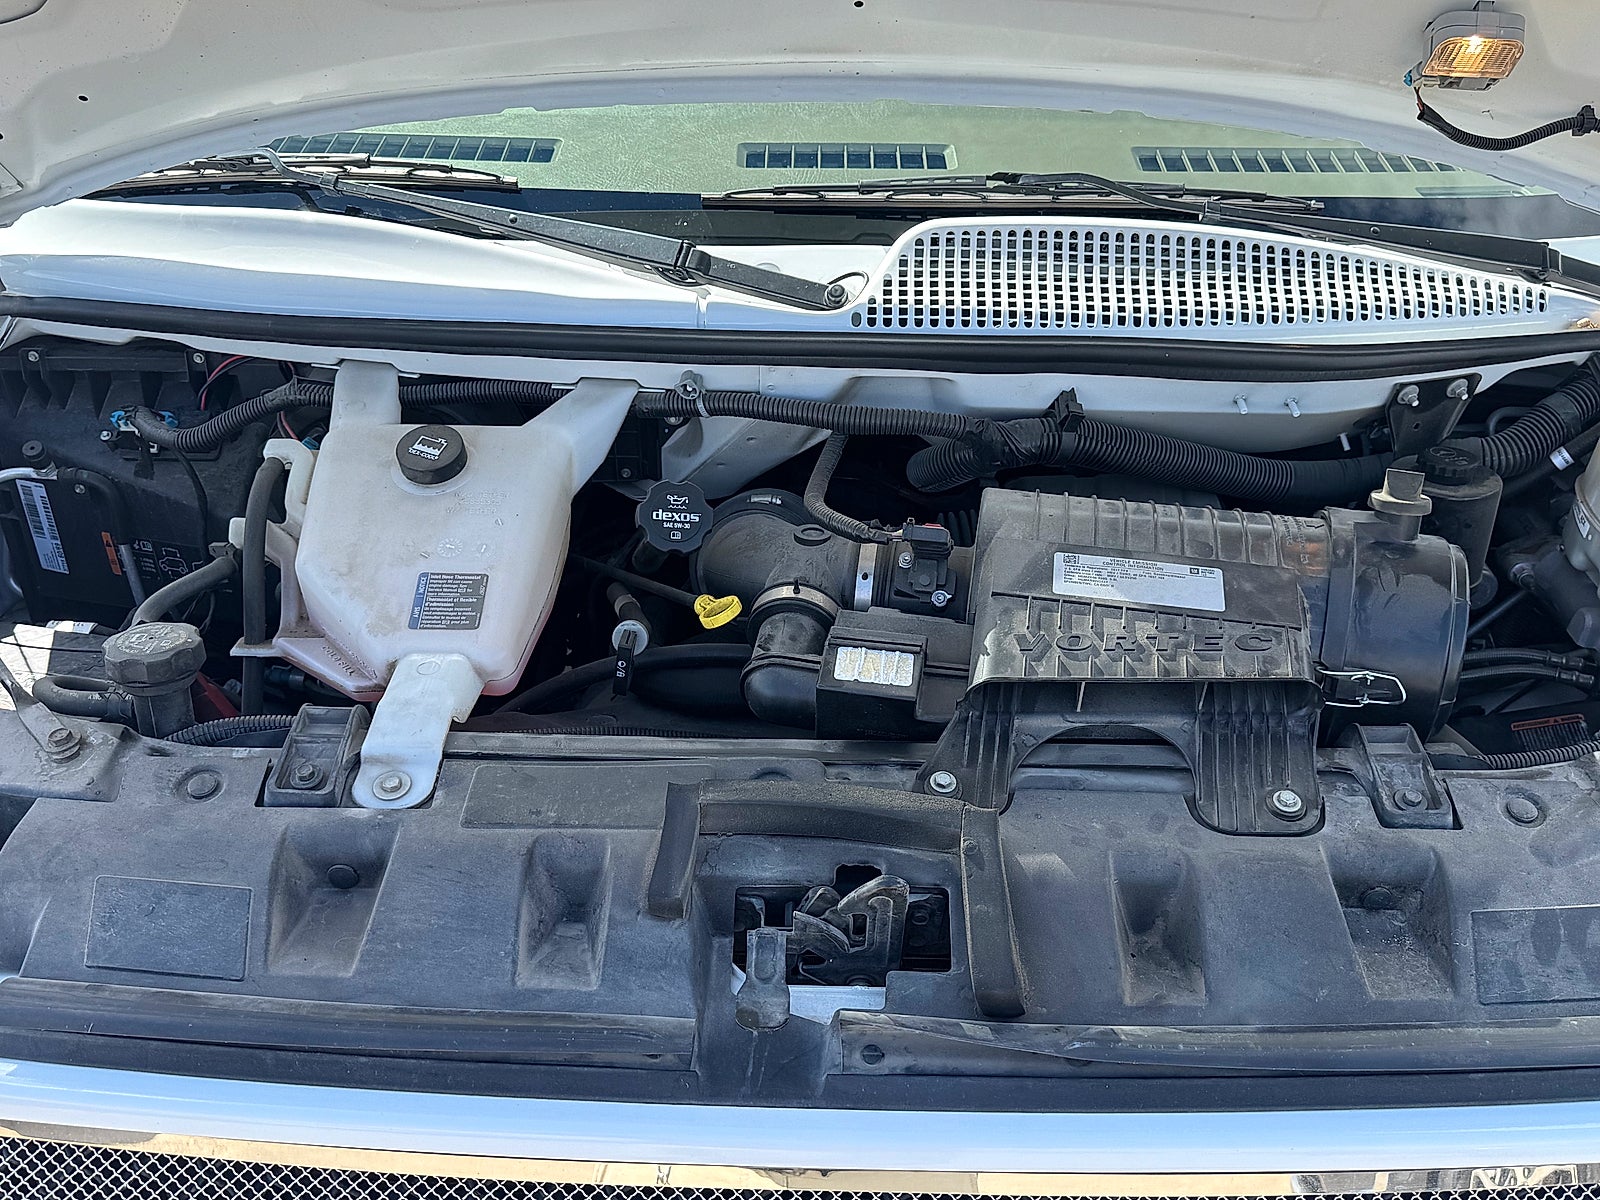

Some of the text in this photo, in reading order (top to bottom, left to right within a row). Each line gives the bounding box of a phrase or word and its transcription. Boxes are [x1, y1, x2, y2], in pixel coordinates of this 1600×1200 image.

[652, 509, 700, 522] dexos
[419, 576, 427, 594] NOTICE
[1013, 633, 1272, 651] VORTEC
